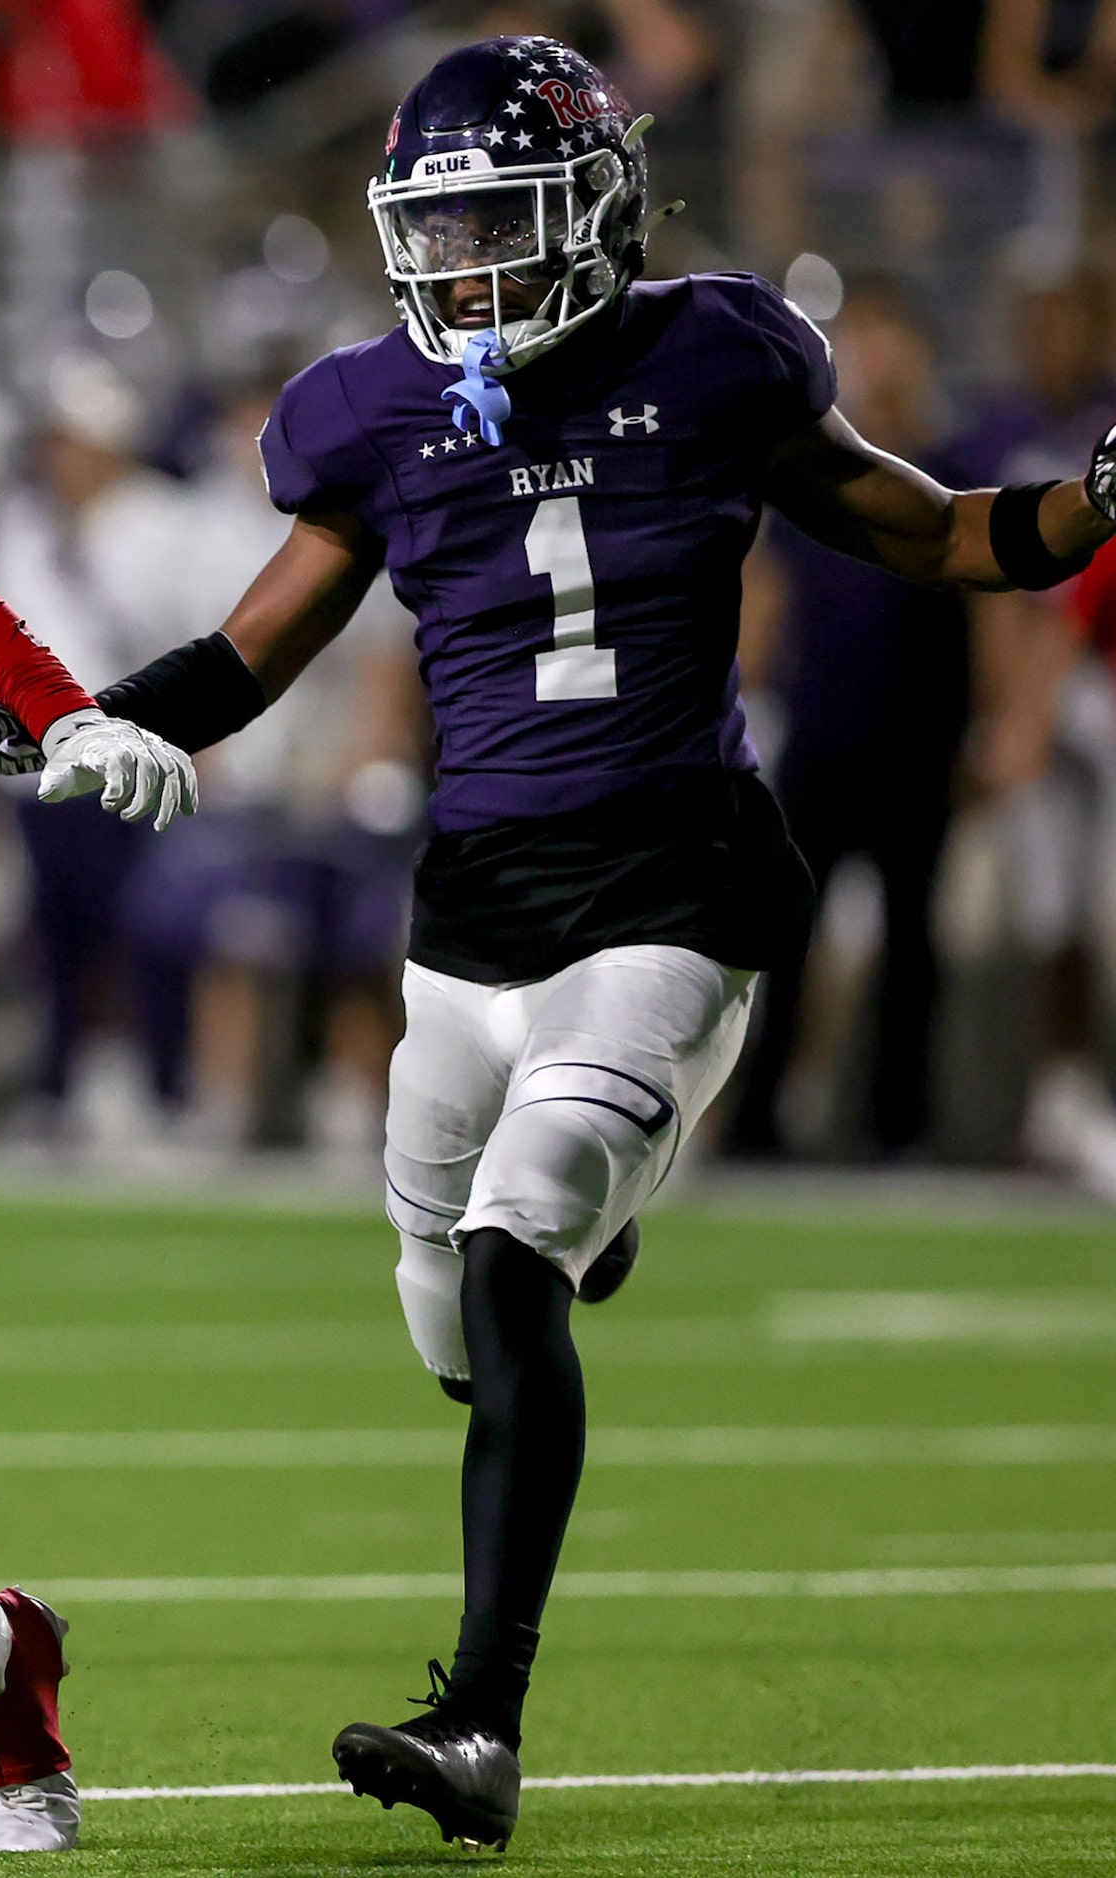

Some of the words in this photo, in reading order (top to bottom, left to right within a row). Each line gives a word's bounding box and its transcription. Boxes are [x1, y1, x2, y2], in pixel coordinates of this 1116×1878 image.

[425, 156, 471, 175] BLUE
[509, 457, 594, 496] RYAN
[524, 496, 617, 701] 1
